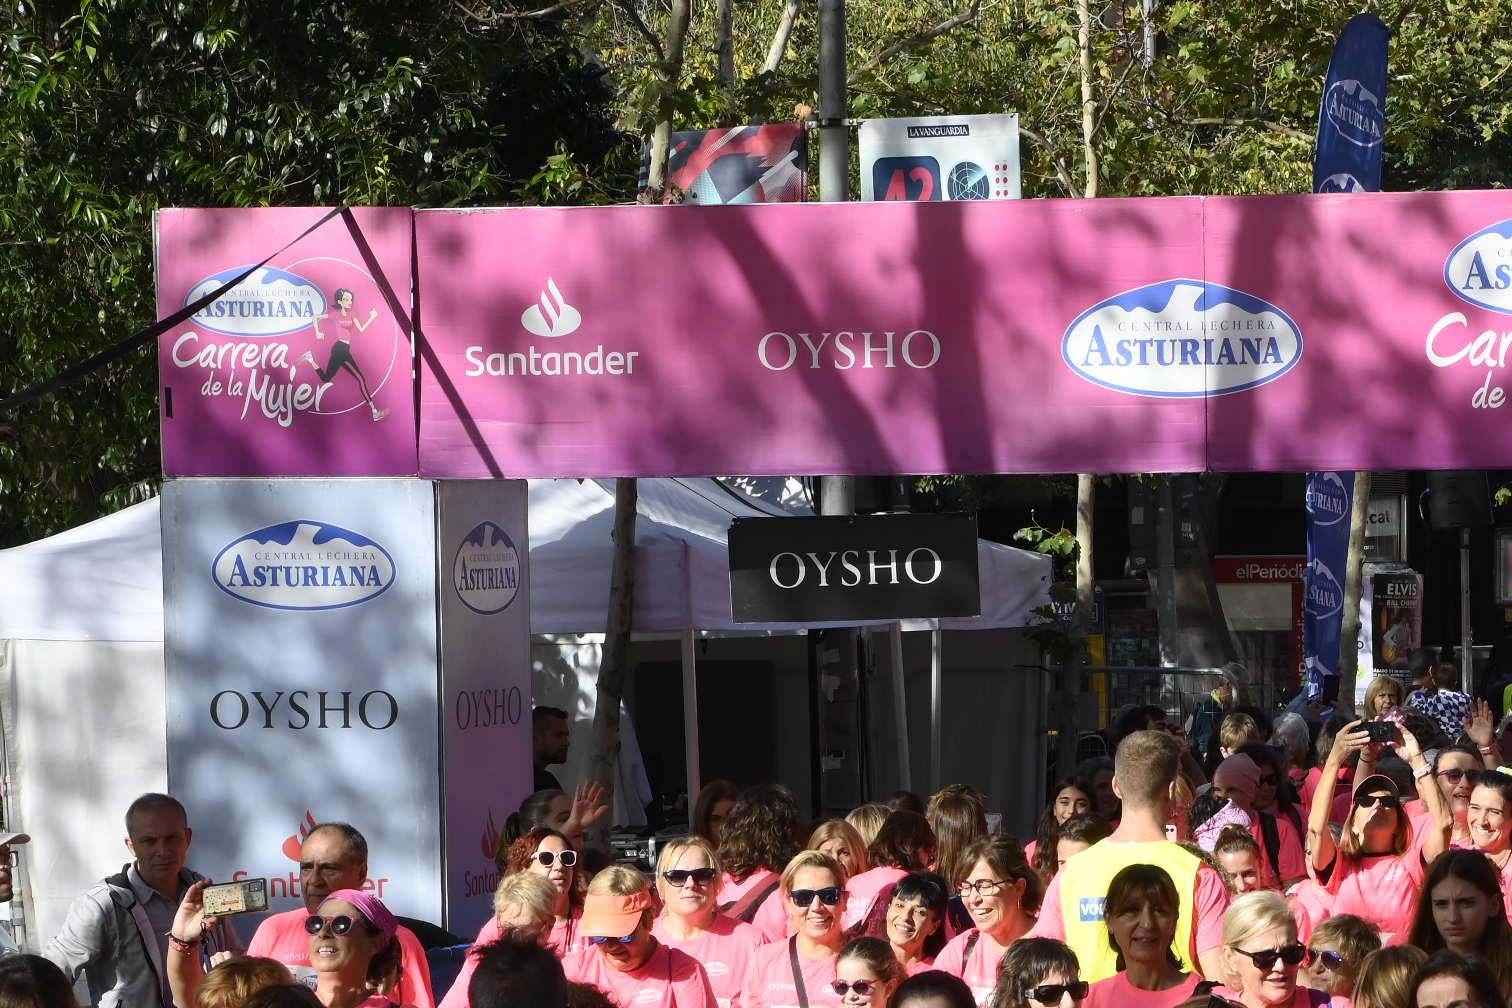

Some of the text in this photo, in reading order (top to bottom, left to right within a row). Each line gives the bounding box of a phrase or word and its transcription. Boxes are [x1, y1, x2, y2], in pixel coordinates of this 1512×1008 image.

[920, 126, 969, 137] VANGUARDIA
[195, 291, 315, 319] ASTURIANA
[221, 289, 261, 298] ENTRAL
[1117, 319, 1276, 332] CENTRAL LECHERA
[172, 331, 290, 369] Carrera
[465, 344, 639, 378] Santander
[757, 329, 942, 372] OYSHO
[1080, 323, 1285, 368] ASTURIANA
[201, 365, 334, 428] de la Mujer
[1472, 370, 1506, 409] de
[226, 553, 383, 588] ASTURIANA
[254, 551, 376, 561] CENTRAL LECHERA
[458, 555, 517, 592] ASTURIANA
[769, 547, 942, 589] OYSHO
[1386, 583, 1417, 596] ELVIS
[209, 689, 399, 730] OYSHO
[455, 686, 522, 731] OYSHO
